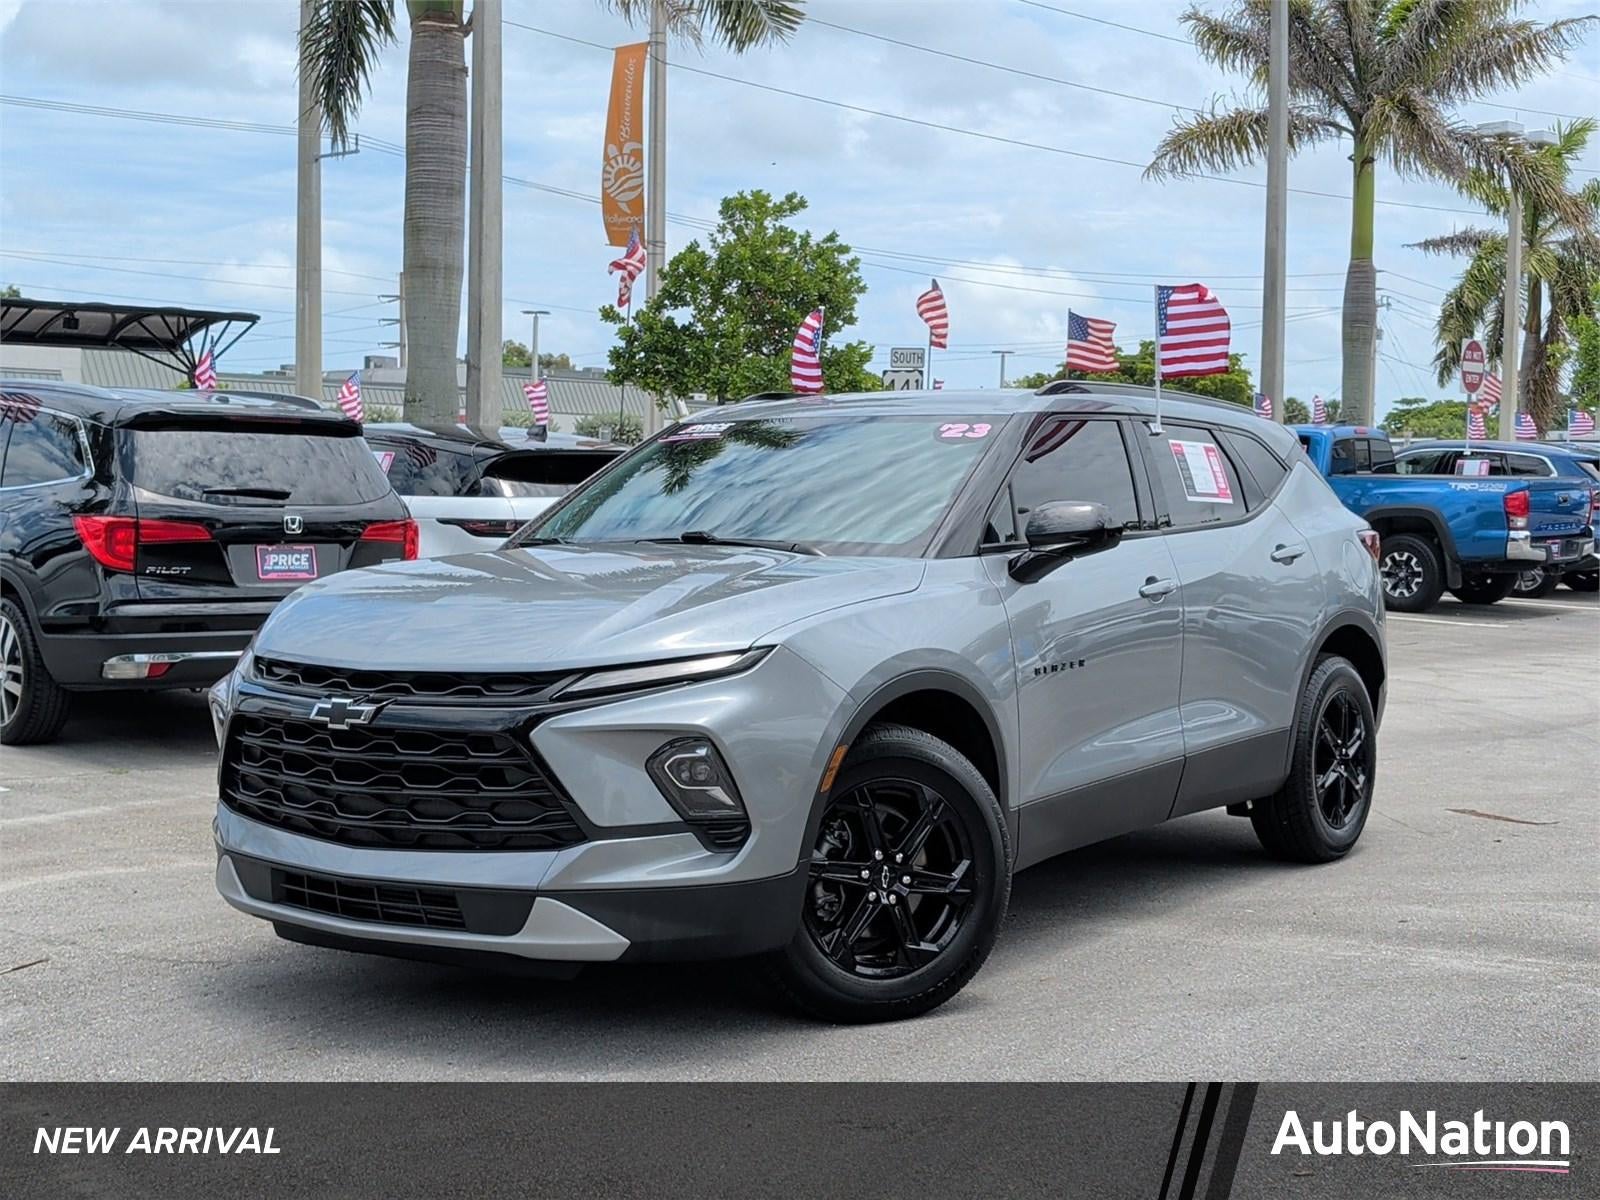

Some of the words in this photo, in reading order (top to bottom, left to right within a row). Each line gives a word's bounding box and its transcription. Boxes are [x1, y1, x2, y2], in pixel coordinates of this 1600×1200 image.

[893, 351, 923, 364] SOUTH
[1465, 350, 1472, 360] DO
[1473, 351, 1482, 361] NOT
[1465, 374, 1480, 384] ENTER
[145, 566, 192, 574] PILOT
